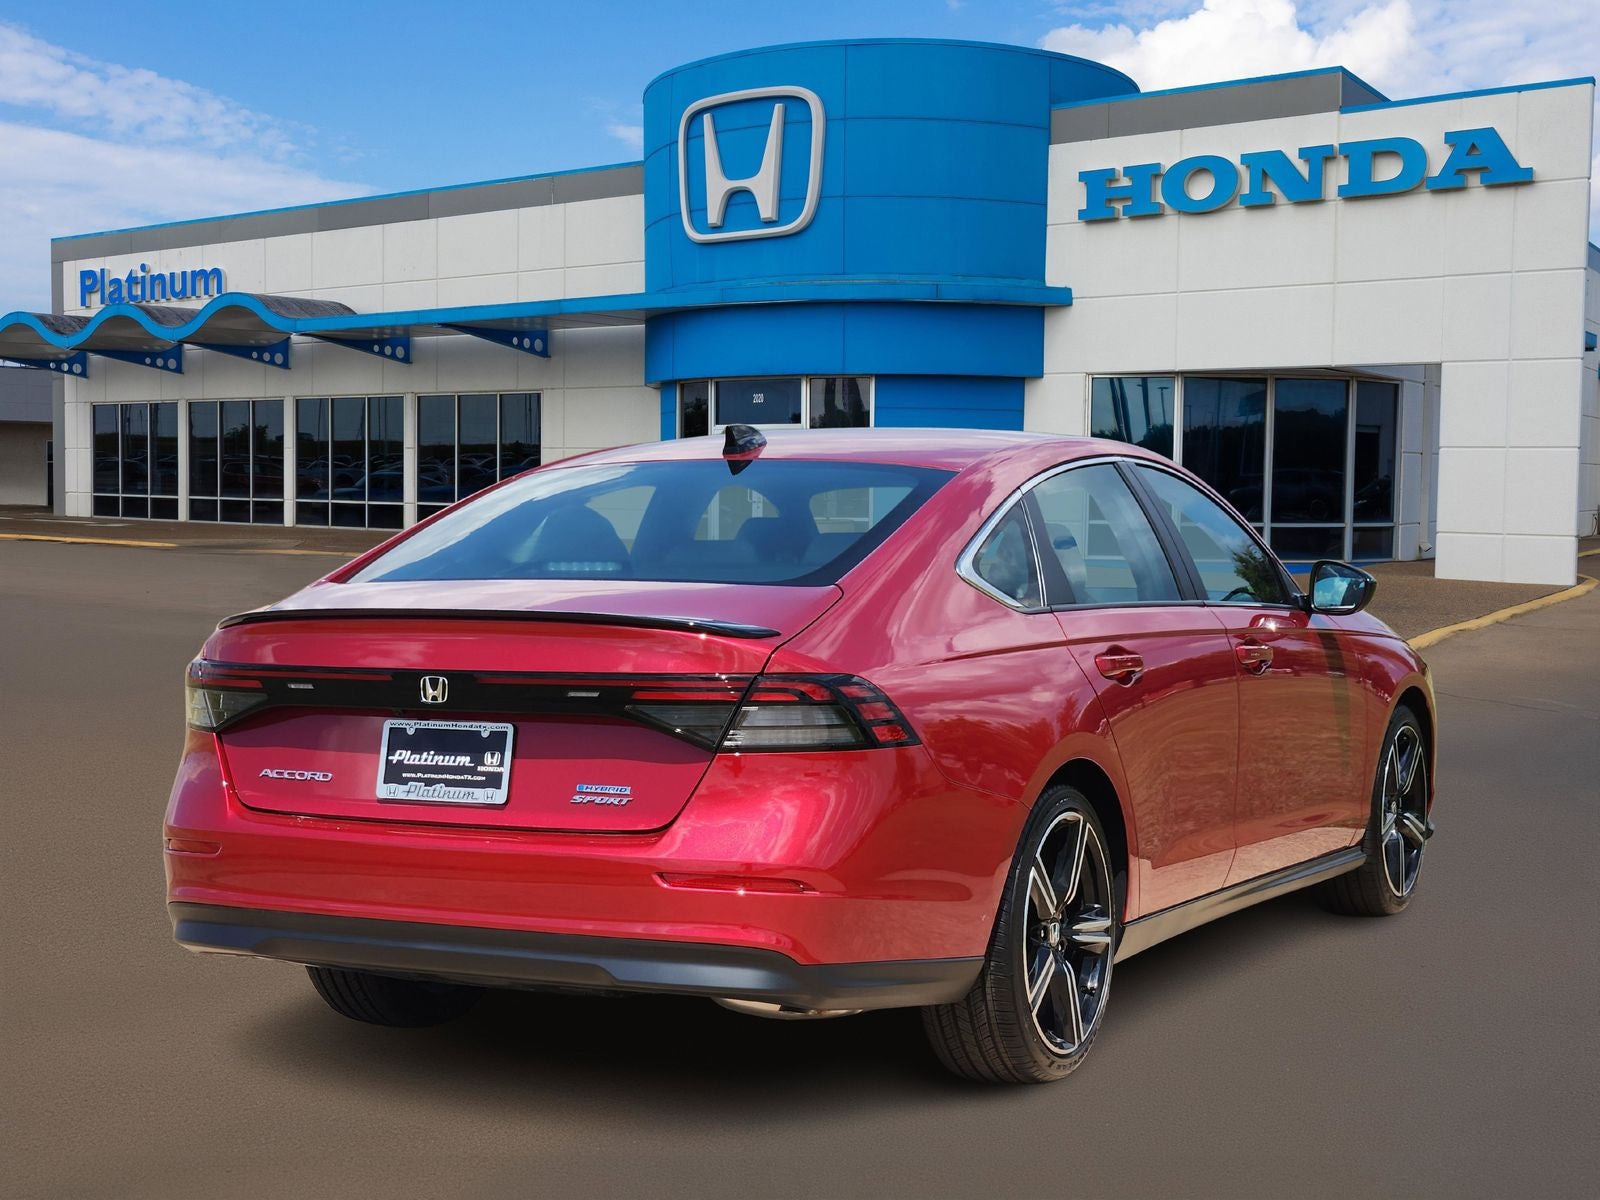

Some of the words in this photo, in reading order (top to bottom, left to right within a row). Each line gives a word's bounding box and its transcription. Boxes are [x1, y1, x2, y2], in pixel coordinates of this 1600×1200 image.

[1078, 127, 1534, 222] HONDA
[79, 264, 224, 307] Platinum
[388, 750, 475, 767] Platinum
[259, 768, 333, 782] ACCORD
[477, 765, 504, 773] HONDA
[403, 783, 479, 801] Platinum
[584, 785, 628, 793] HYBRID
[569, 794, 635, 805] SPORT
